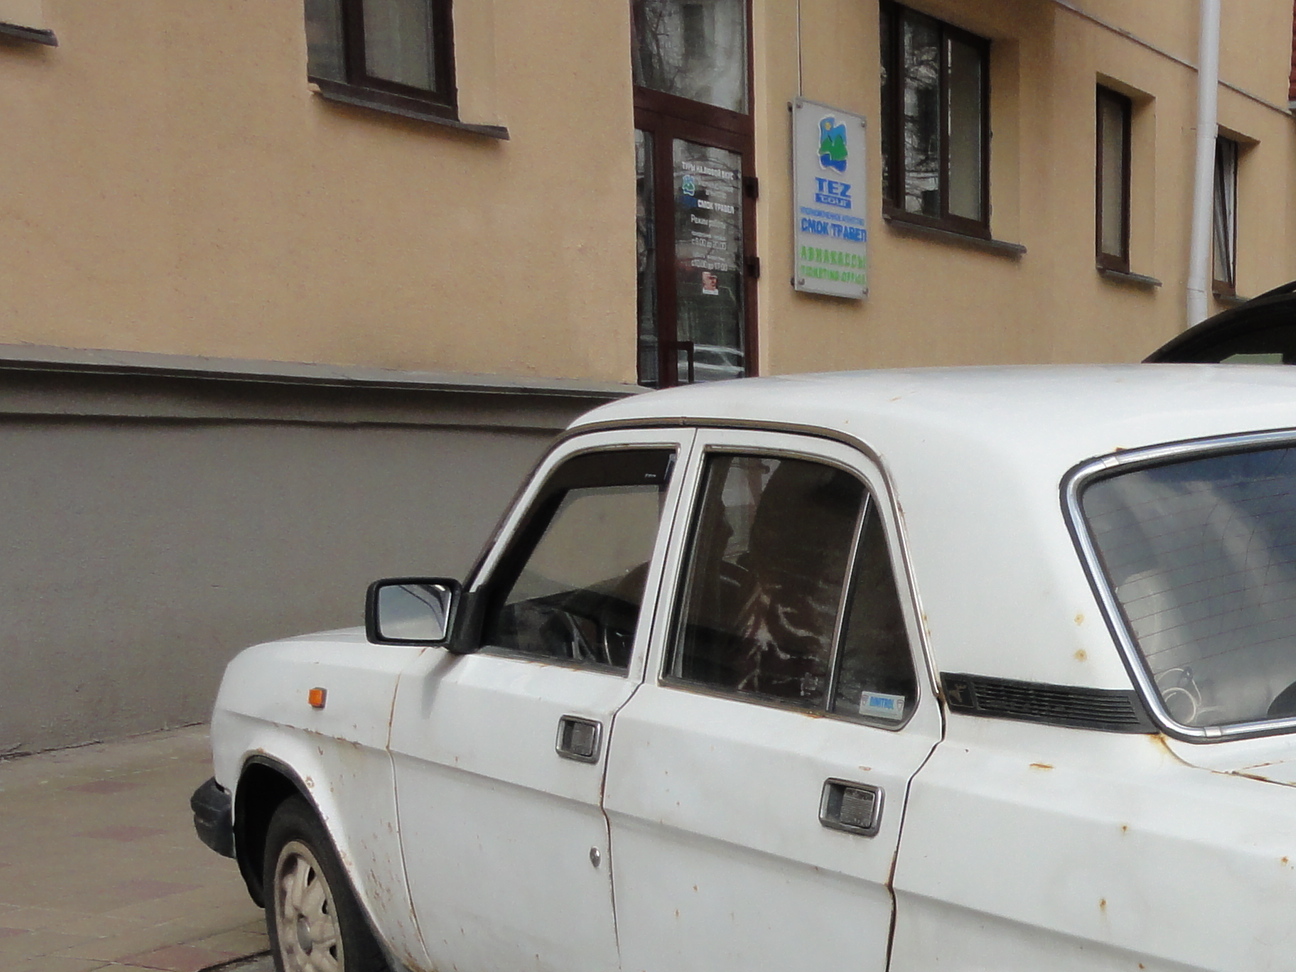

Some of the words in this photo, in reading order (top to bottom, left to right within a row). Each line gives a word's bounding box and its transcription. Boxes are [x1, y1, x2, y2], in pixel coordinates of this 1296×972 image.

[815, 177, 851, 198] TEZ
[801, 217, 829, 235] СМОК
[830, 223, 867, 242] ТРАВЕЛ
